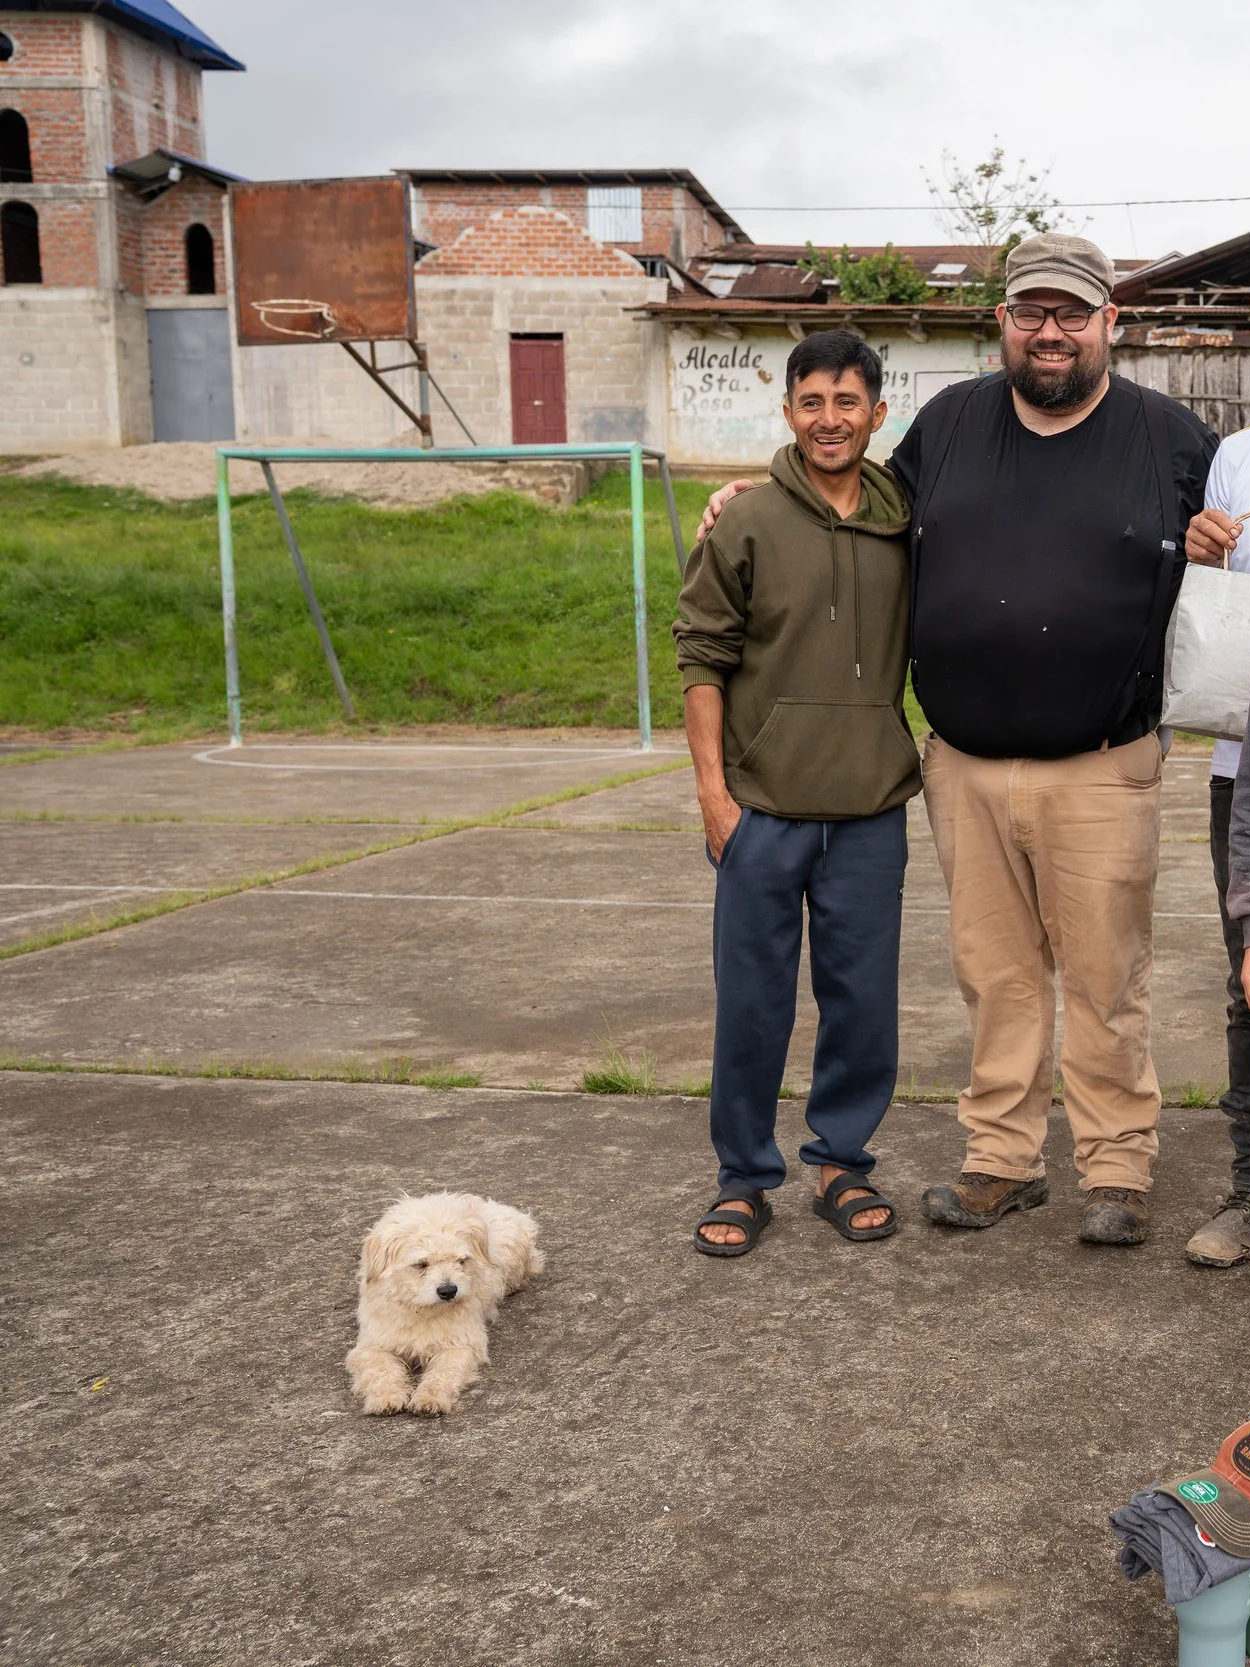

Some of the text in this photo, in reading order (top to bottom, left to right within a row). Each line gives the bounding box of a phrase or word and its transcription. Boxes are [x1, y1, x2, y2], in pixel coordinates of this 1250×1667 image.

[679, 345, 763, 369] Alcalde
[699, 373, 750, 393] Sta.
[677, 385, 733, 415] Rosa
